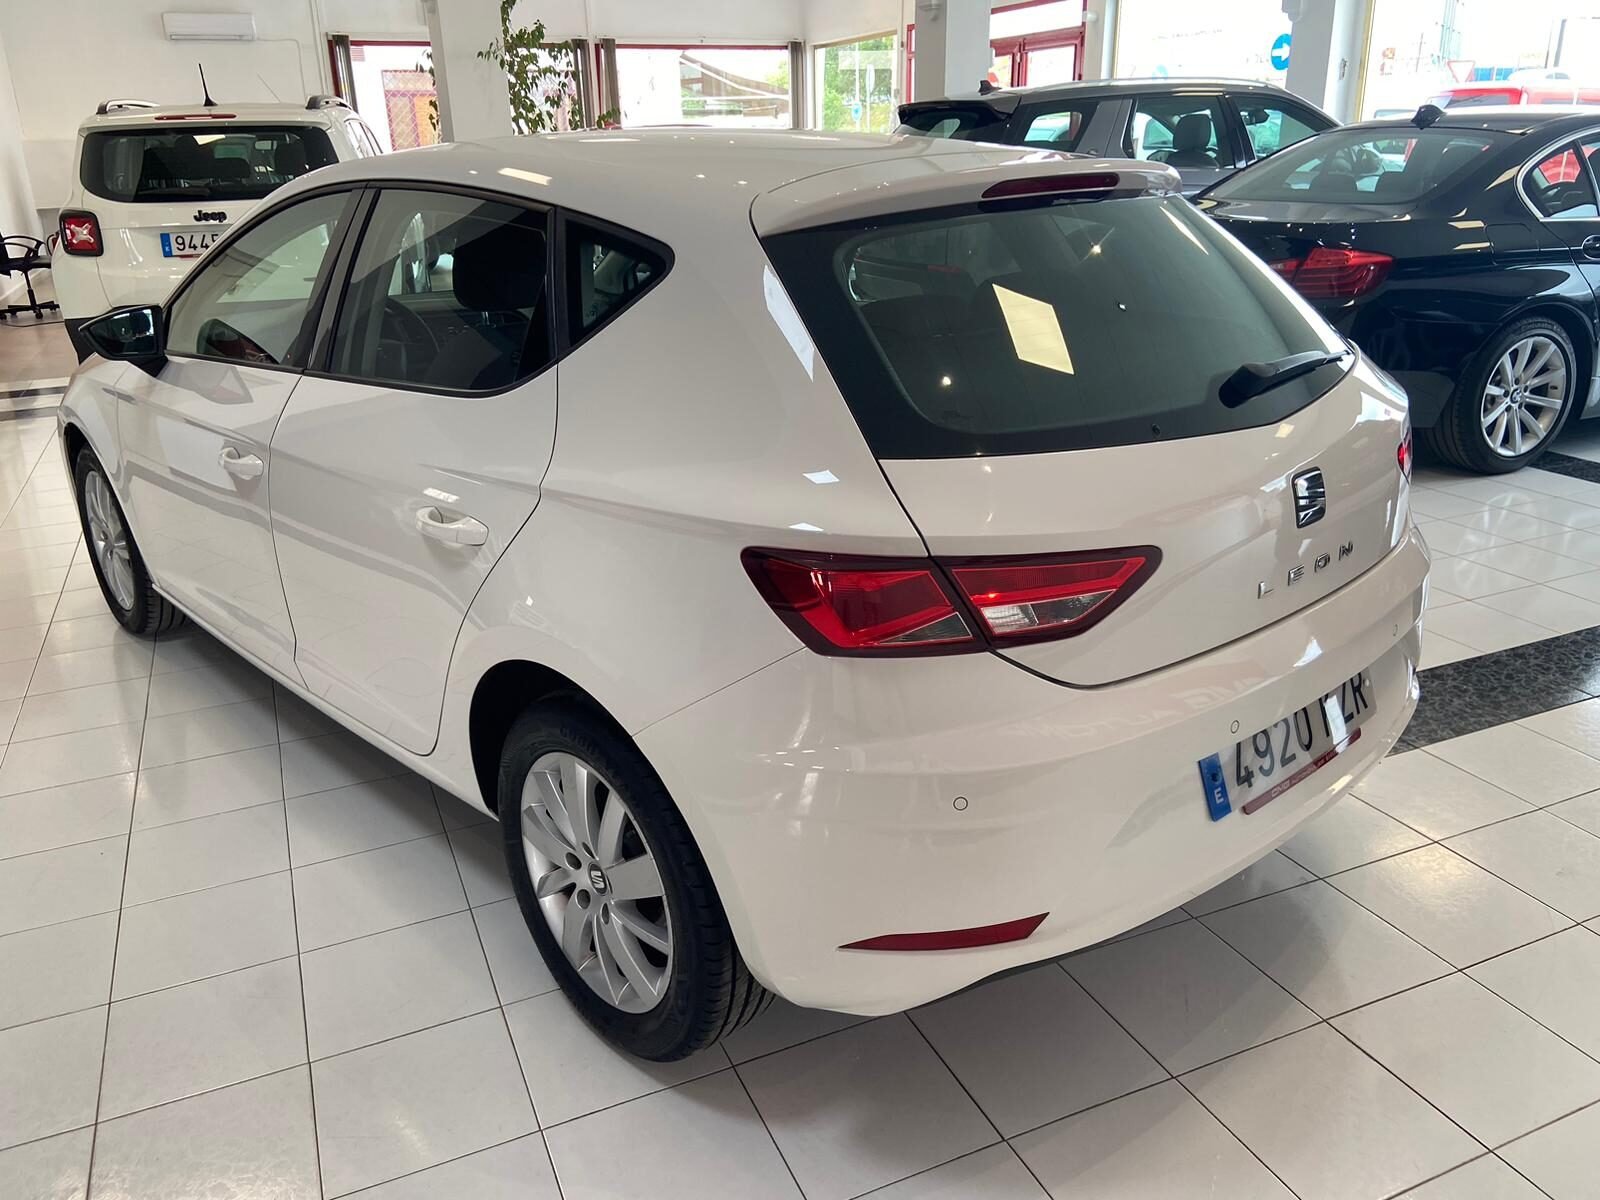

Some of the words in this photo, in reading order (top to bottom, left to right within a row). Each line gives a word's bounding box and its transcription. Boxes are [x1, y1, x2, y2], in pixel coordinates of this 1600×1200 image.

[193, 210, 227, 223] Jeep
[1257, 541, 1355, 600] LEON
[1213, 787, 1225, 804] E
[1235, 706, 1313, 788] 4920
